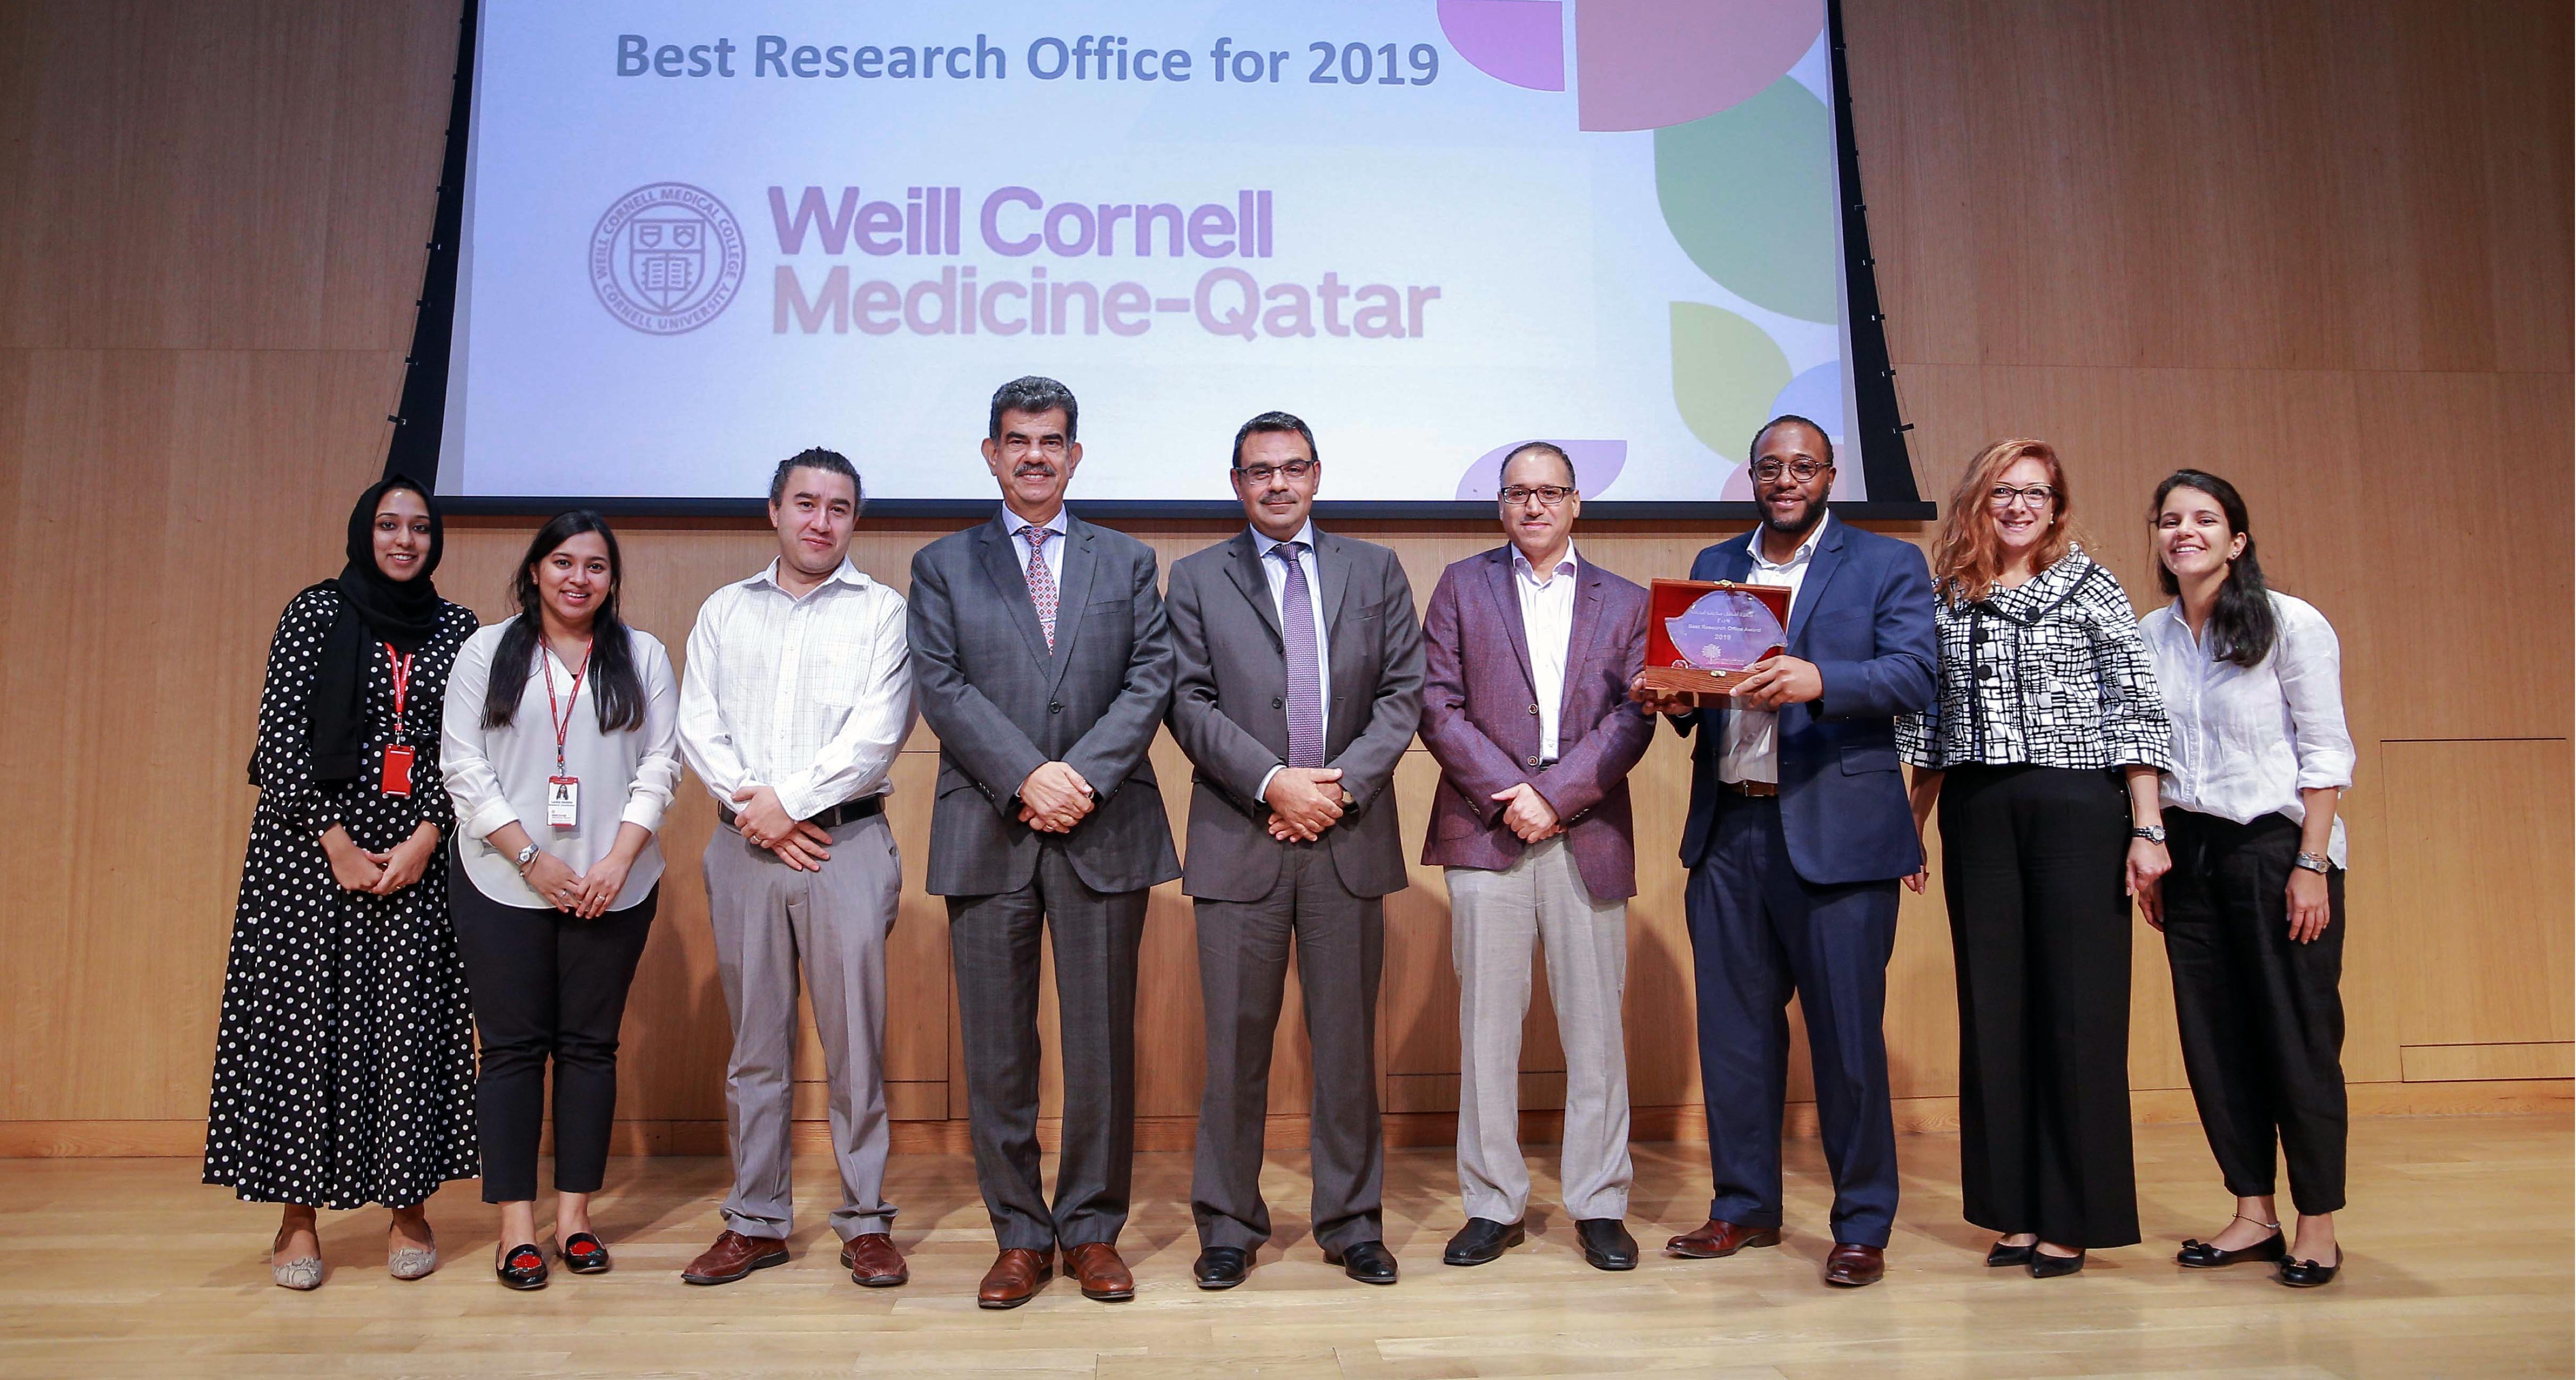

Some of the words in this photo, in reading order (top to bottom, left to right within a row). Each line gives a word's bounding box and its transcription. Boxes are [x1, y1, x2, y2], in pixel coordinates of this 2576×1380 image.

[616, 34, 737, 78] Best
[755, 34, 1007, 80] Research
[1027, 35, 1193, 83] Office
[1210, 37, 1290, 84] for
[1309, 41, 1440, 87] 2019
[595, 238, 609, 279] WEILL
[604, 190, 657, 234] CORNELL
[661, 189, 719, 219] MEDICAL
[719, 219, 739, 278] COLLEGE
[767, 186, 962, 258] Weill
[980, 186, 1274, 259] Cornell
[602, 283, 652, 328] CORNELL
[658, 283, 730, 329] UNIVERSITY
[773, 265, 1442, 343] Medicine-Qatar
